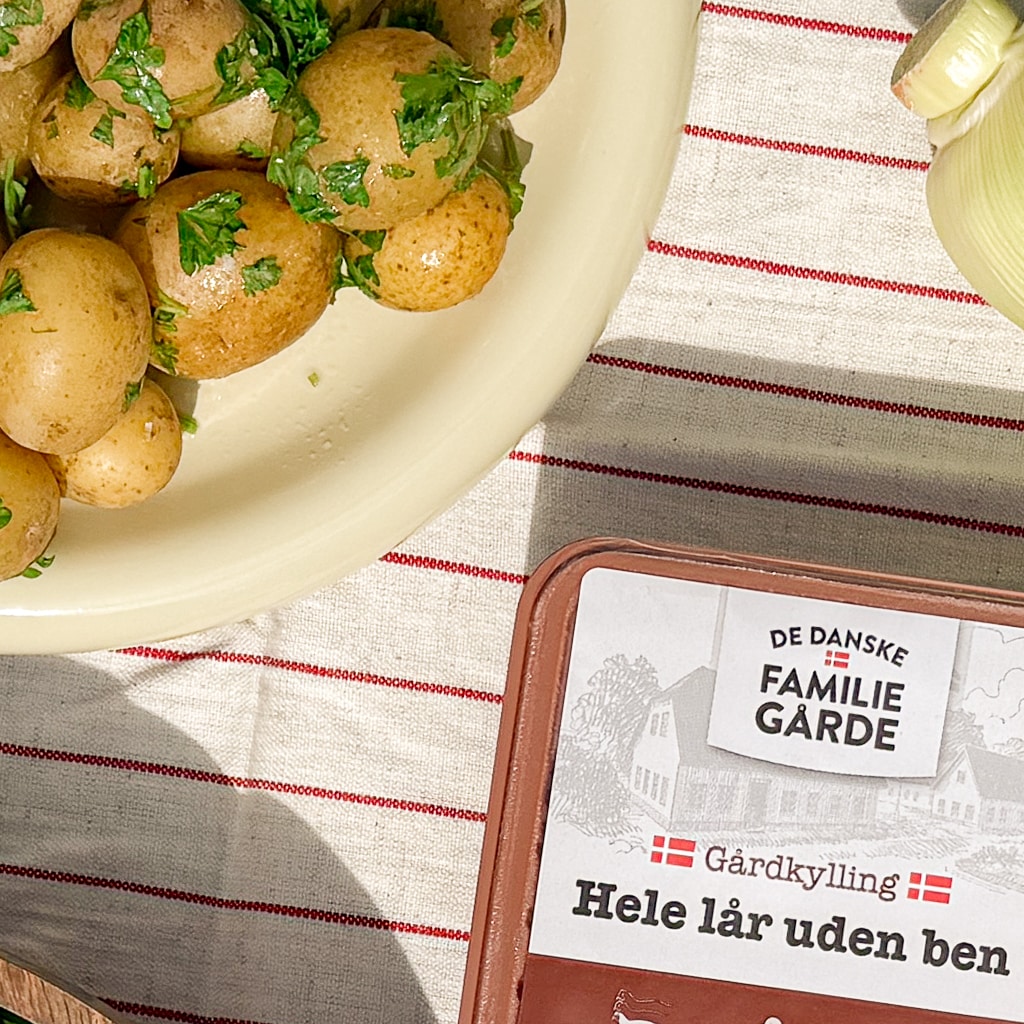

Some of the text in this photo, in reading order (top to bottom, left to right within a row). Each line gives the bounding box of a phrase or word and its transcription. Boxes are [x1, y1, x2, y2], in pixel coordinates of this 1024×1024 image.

[770, 626, 909, 667] DE DANSKE
[760, 664, 905, 712] FAMILIE
[755, 701, 899, 751] GÅRDE
[705, 846, 899, 902] Gårdkylling
[572, 880, 1010, 976] Hele lår uden ben
